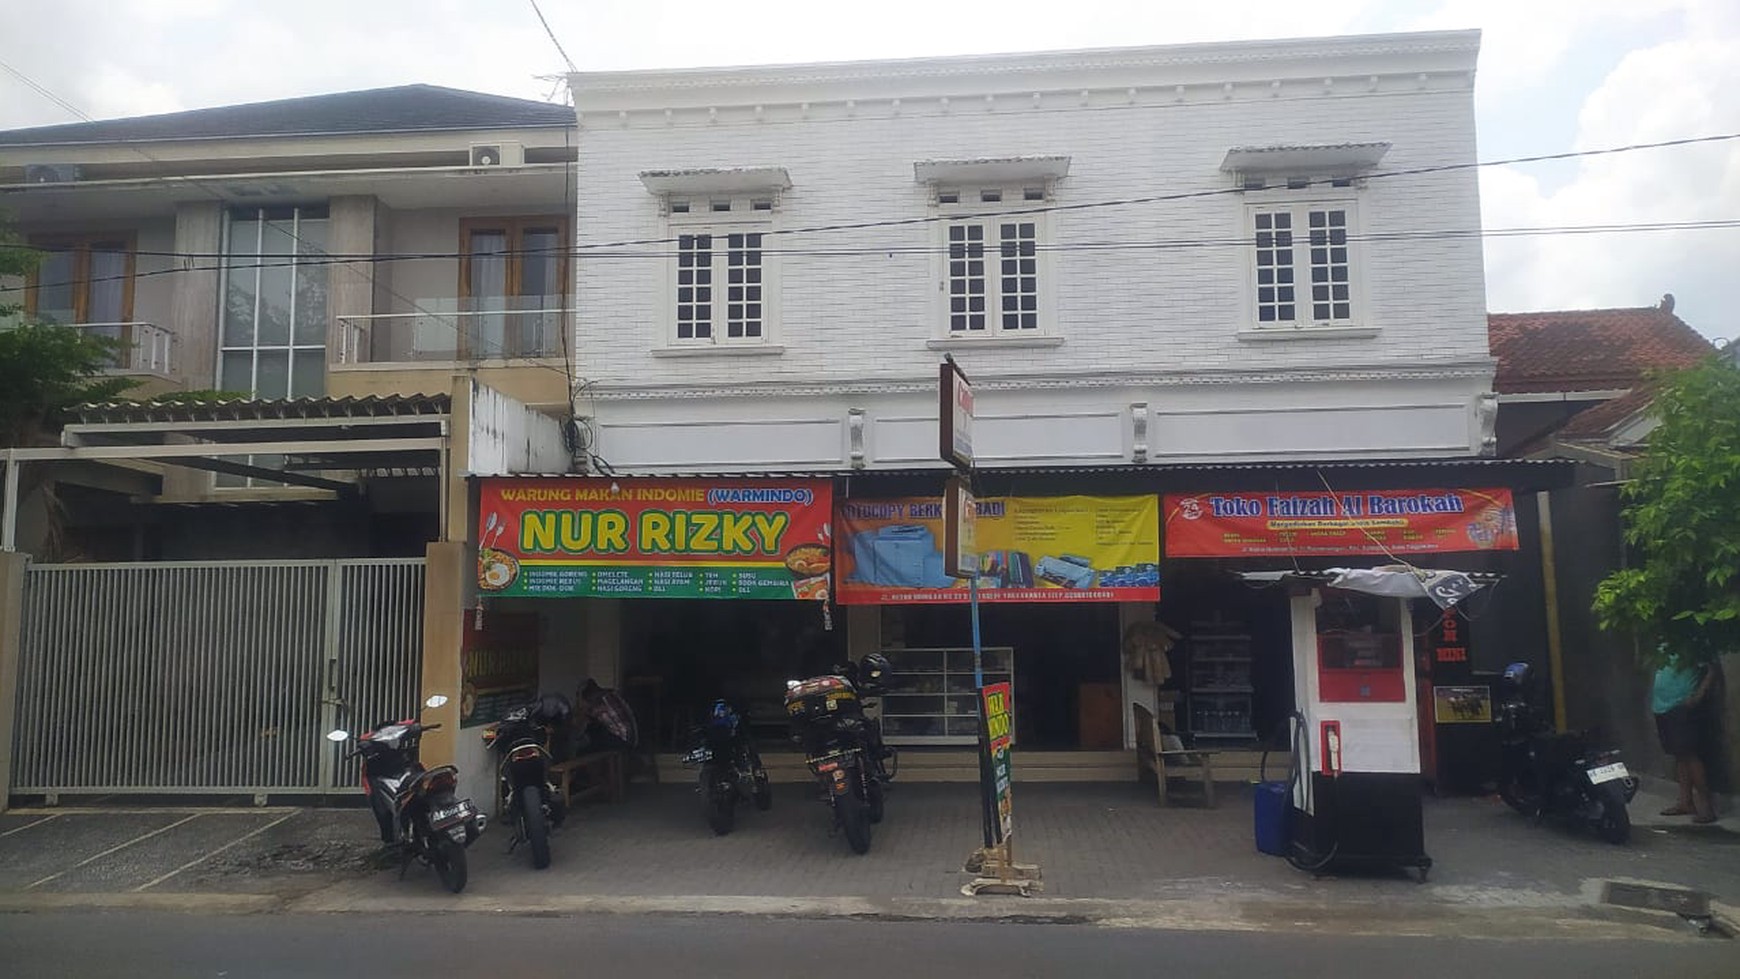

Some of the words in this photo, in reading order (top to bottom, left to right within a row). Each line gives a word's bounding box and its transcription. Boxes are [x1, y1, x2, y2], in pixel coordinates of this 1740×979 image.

[501, 489, 571, 502] WARUNG
[575, 489, 635, 502] MAKAN
[637, 489, 704, 502] INDOMIE
[707, 488, 813, 504] (WARMINDO)
[1210, 497, 1261, 517] Toko
[1266, 496, 1336, 517] Faizah
[1340, 495, 1363, 516] Al
[1369, 494, 1463, 516] Barokah
[909, 503, 943, 519] BERK
[521, 509, 629, 553] NUR
[639, 510, 788, 553] RIZKY
